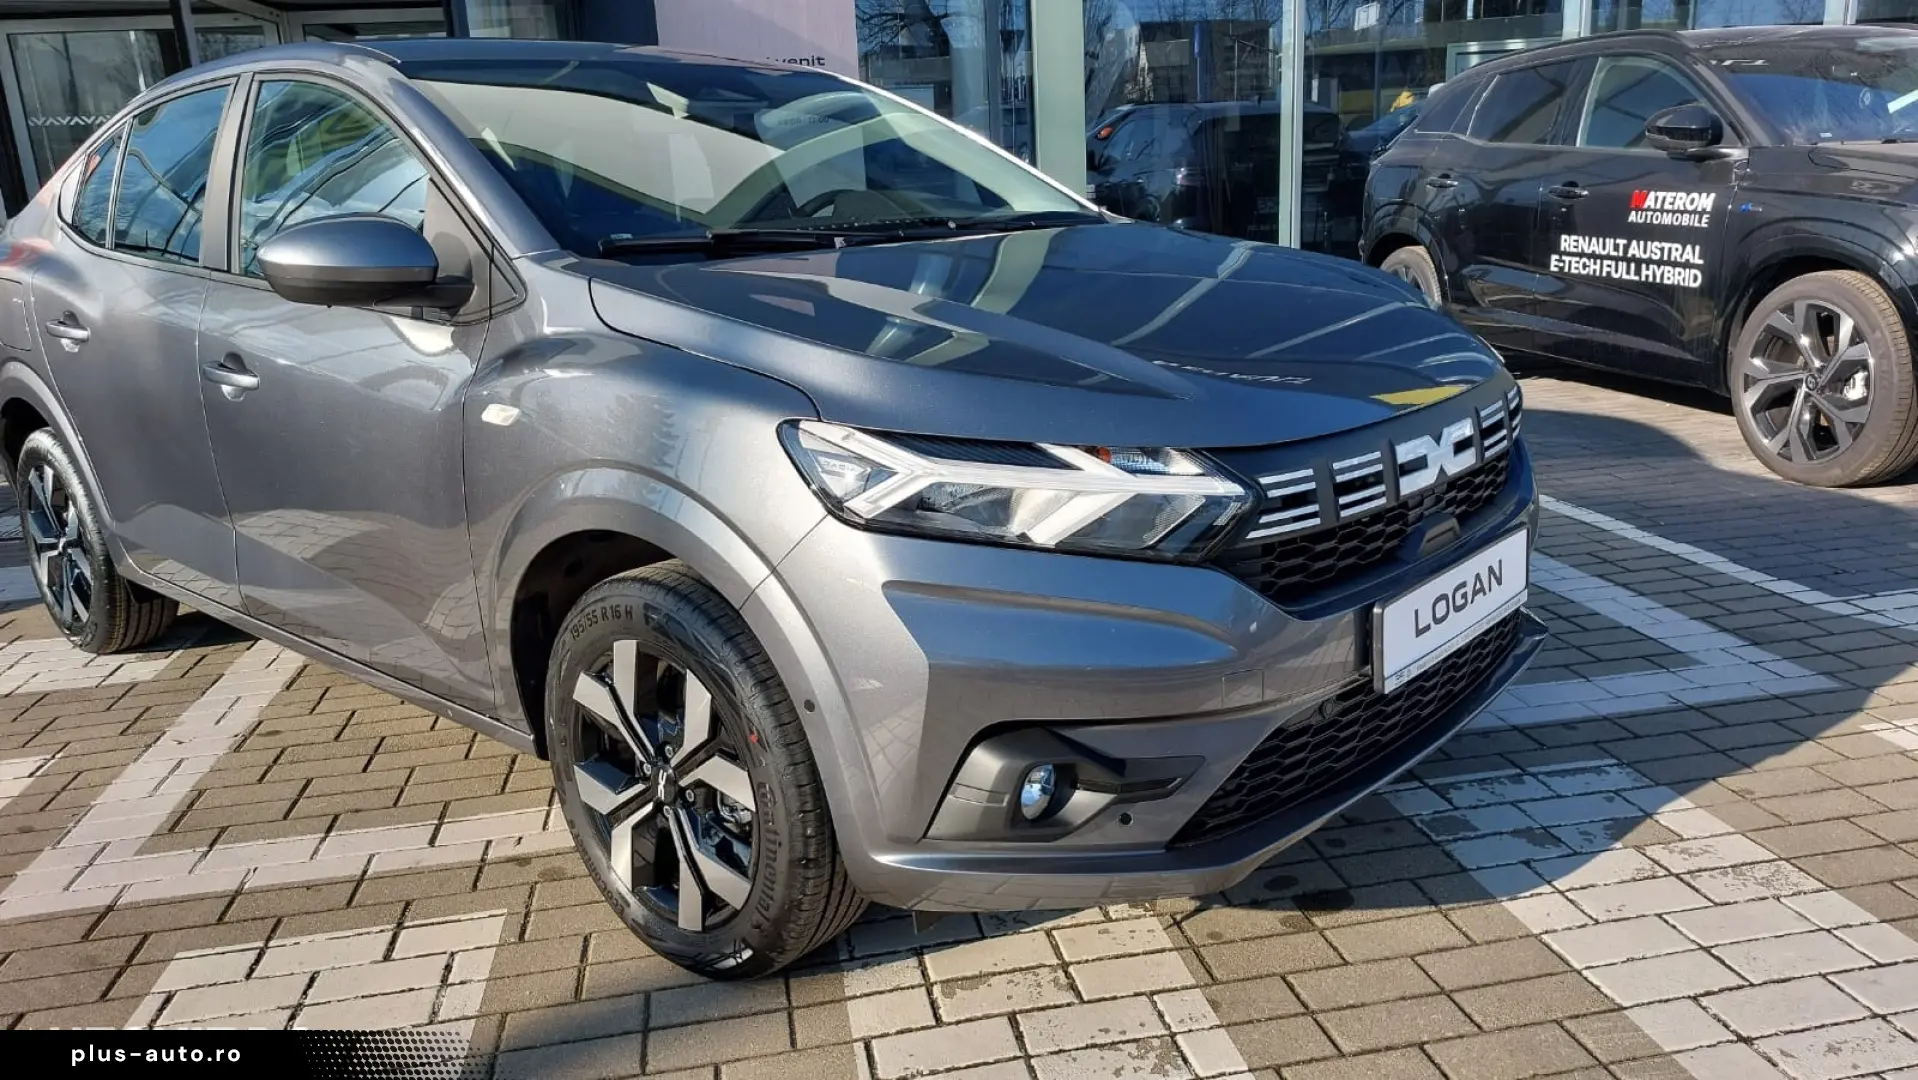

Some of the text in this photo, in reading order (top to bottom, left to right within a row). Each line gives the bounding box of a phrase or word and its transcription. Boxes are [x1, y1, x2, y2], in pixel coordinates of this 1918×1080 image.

[1629, 190, 1716, 212] MATEROM
[1627, 210, 1711, 228] AUTOMOBILE
[1560, 234, 1704, 264] RENAULT AUSTRAL
[1550, 254, 1703, 289] E-TECH FULL HYBRID
[1414, 558, 1503, 639] LOGAN
[570, 609, 599, 641] 195/55
[624, 604, 634, 621] H
